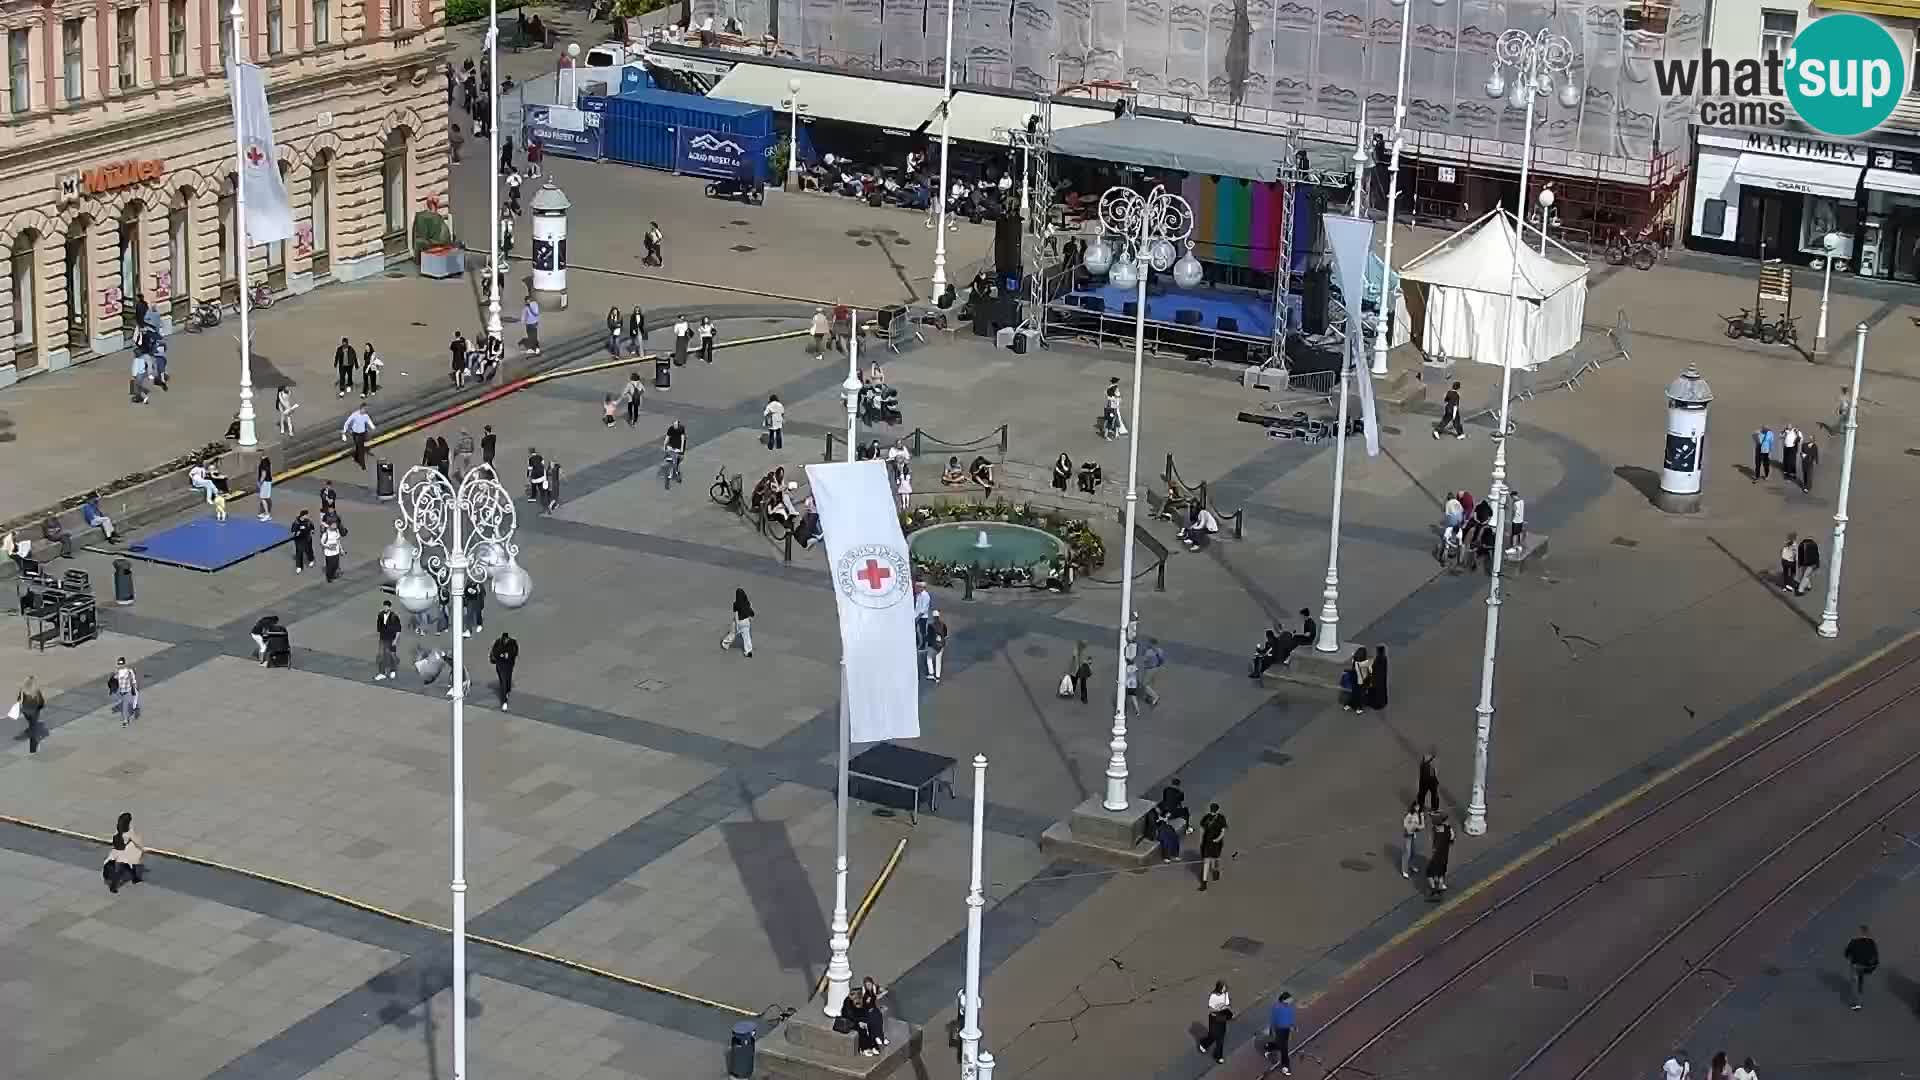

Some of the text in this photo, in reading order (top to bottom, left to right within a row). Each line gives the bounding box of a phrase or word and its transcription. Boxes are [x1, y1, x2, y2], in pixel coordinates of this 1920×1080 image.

[1746, 132, 1857, 162] MARTIMEX
[79, 159, 165, 193] Müller
[1776, 181, 1812, 193] CHANEL
